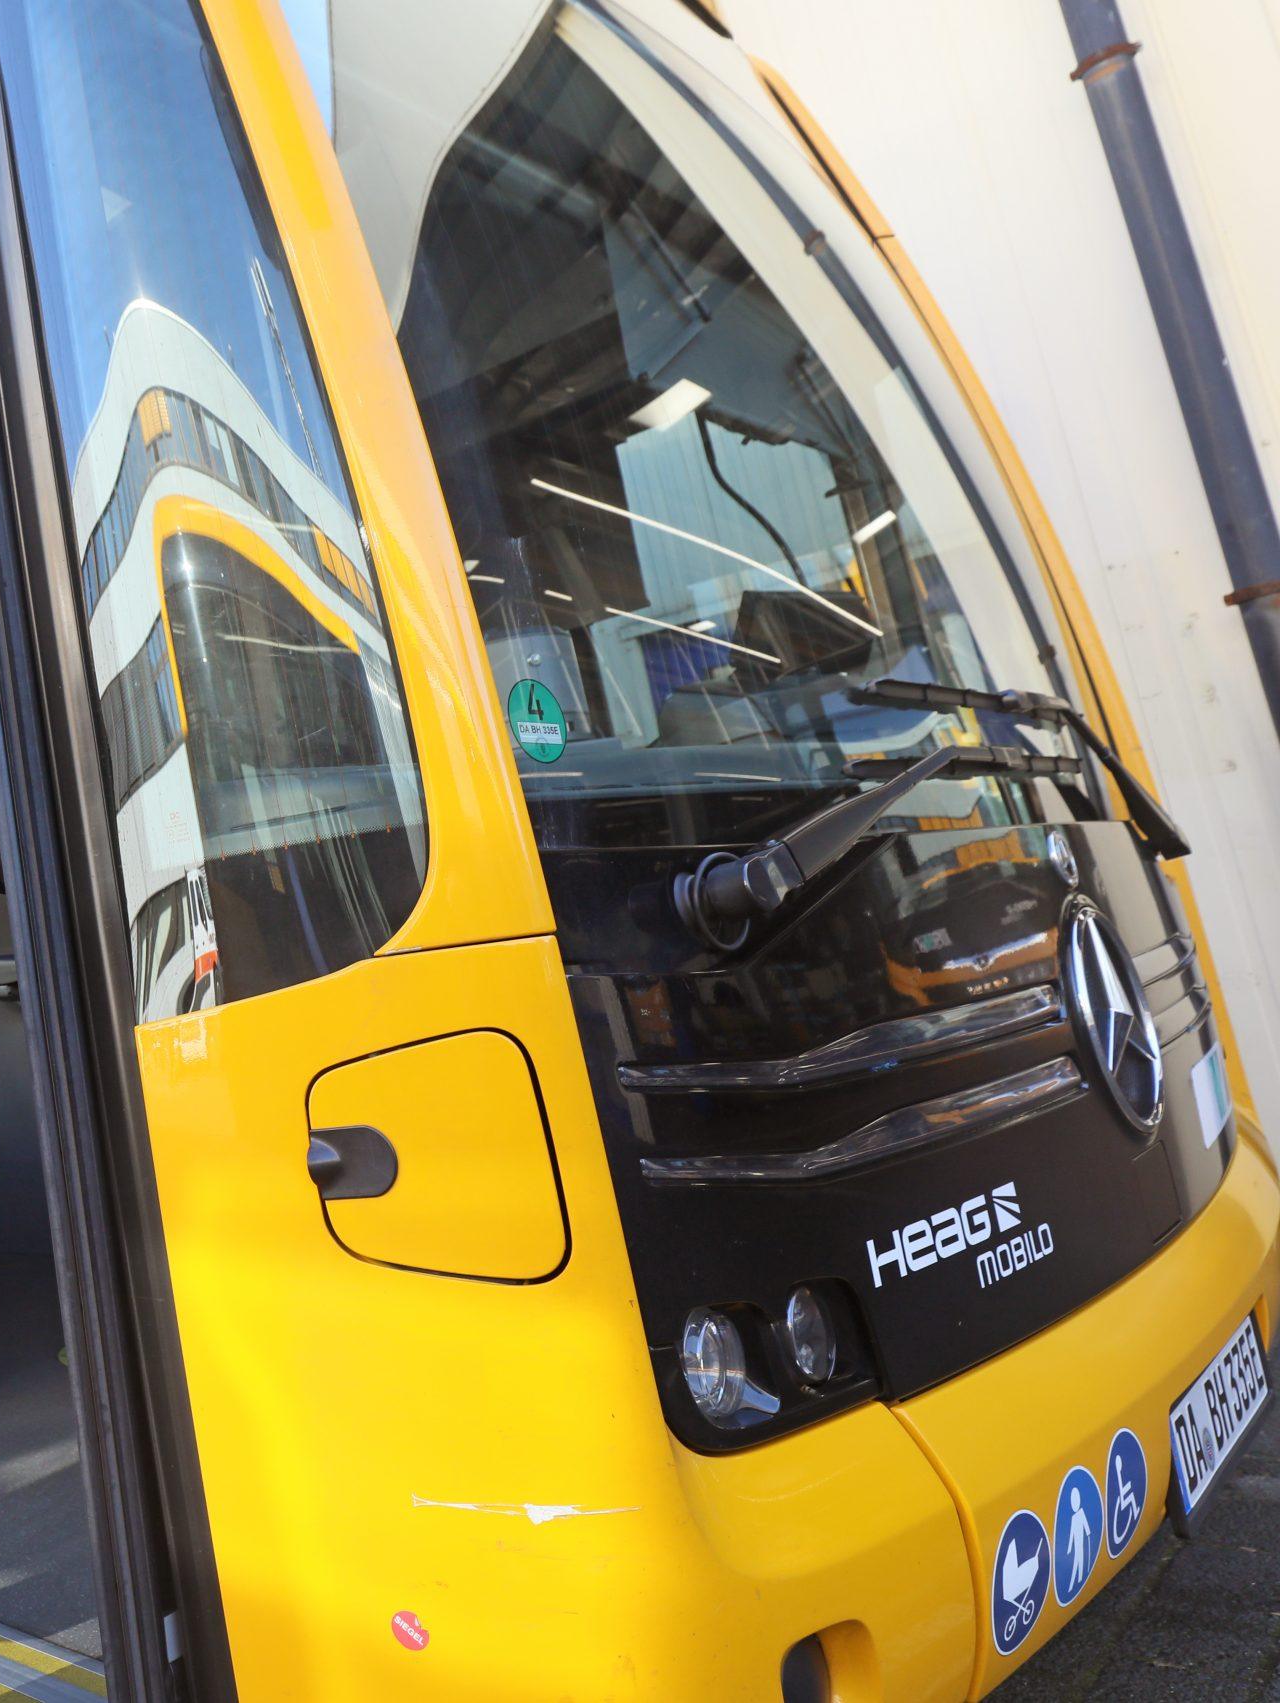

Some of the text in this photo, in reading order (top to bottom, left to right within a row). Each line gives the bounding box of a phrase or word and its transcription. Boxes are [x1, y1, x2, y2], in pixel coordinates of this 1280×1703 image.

[528, 684, 544, 720] 4
[519, 725, 530, 733] DA
[531, 725, 542, 734] BH
[1175, 1324, 1265, 1494] DA BH 335E
[394, 1615, 424, 1646] SIEGEL
